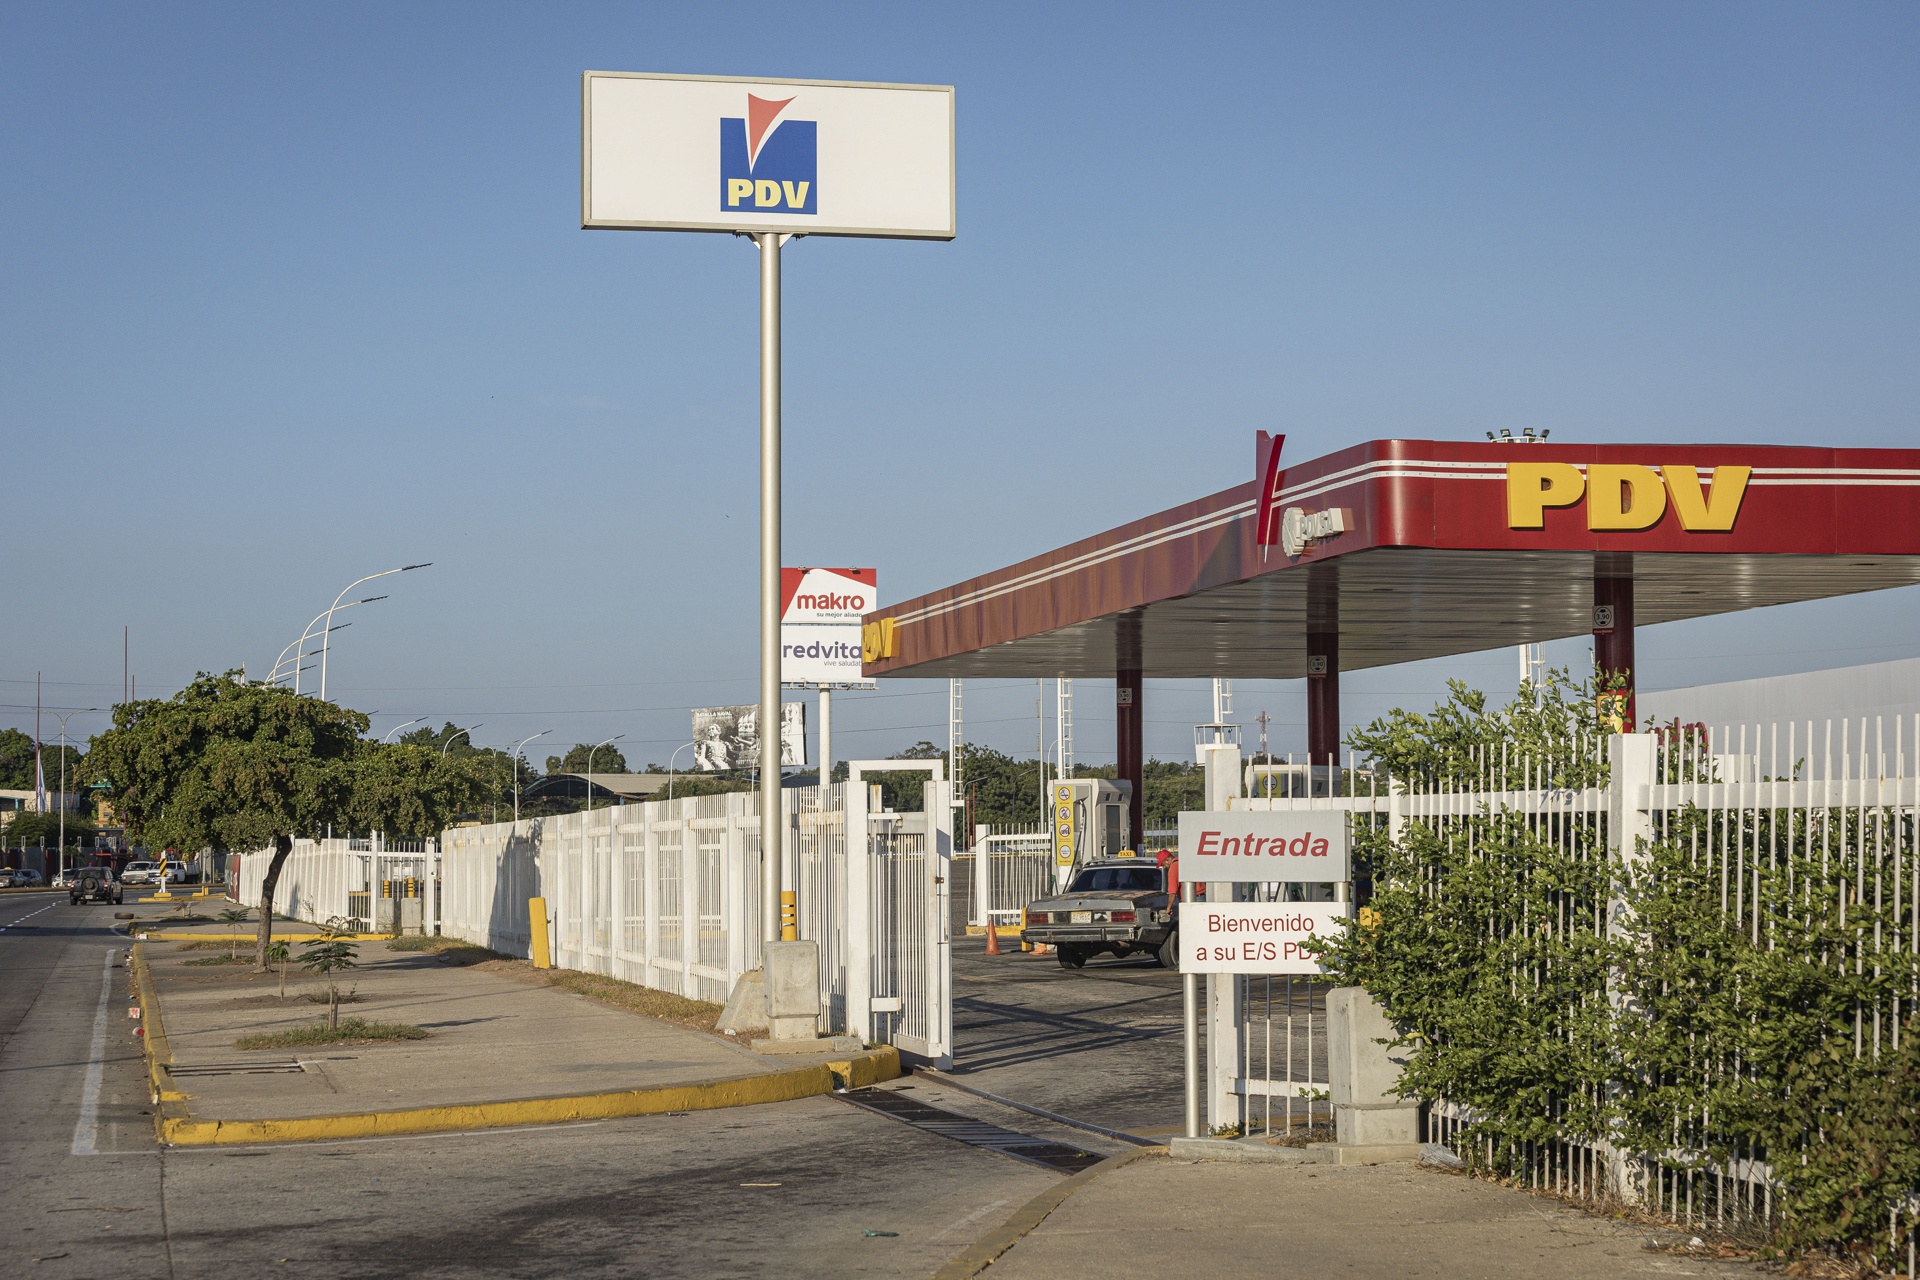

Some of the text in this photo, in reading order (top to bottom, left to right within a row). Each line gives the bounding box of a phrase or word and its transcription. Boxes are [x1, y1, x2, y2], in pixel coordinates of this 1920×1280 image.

[727, 178, 810, 209] PDV
[1506, 462, 1752, 532] PDV
[797, 592, 865, 610] makro
[783, 641, 862, 659] redvita
[1197, 831, 1329, 857] Entrada
[1208, 914, 1314, 932] Bienvenido
[1196, 947, 1207, 961] a
[1214, 947, 1236, 961] su
[1243, 942, 1277, 961] E/S
